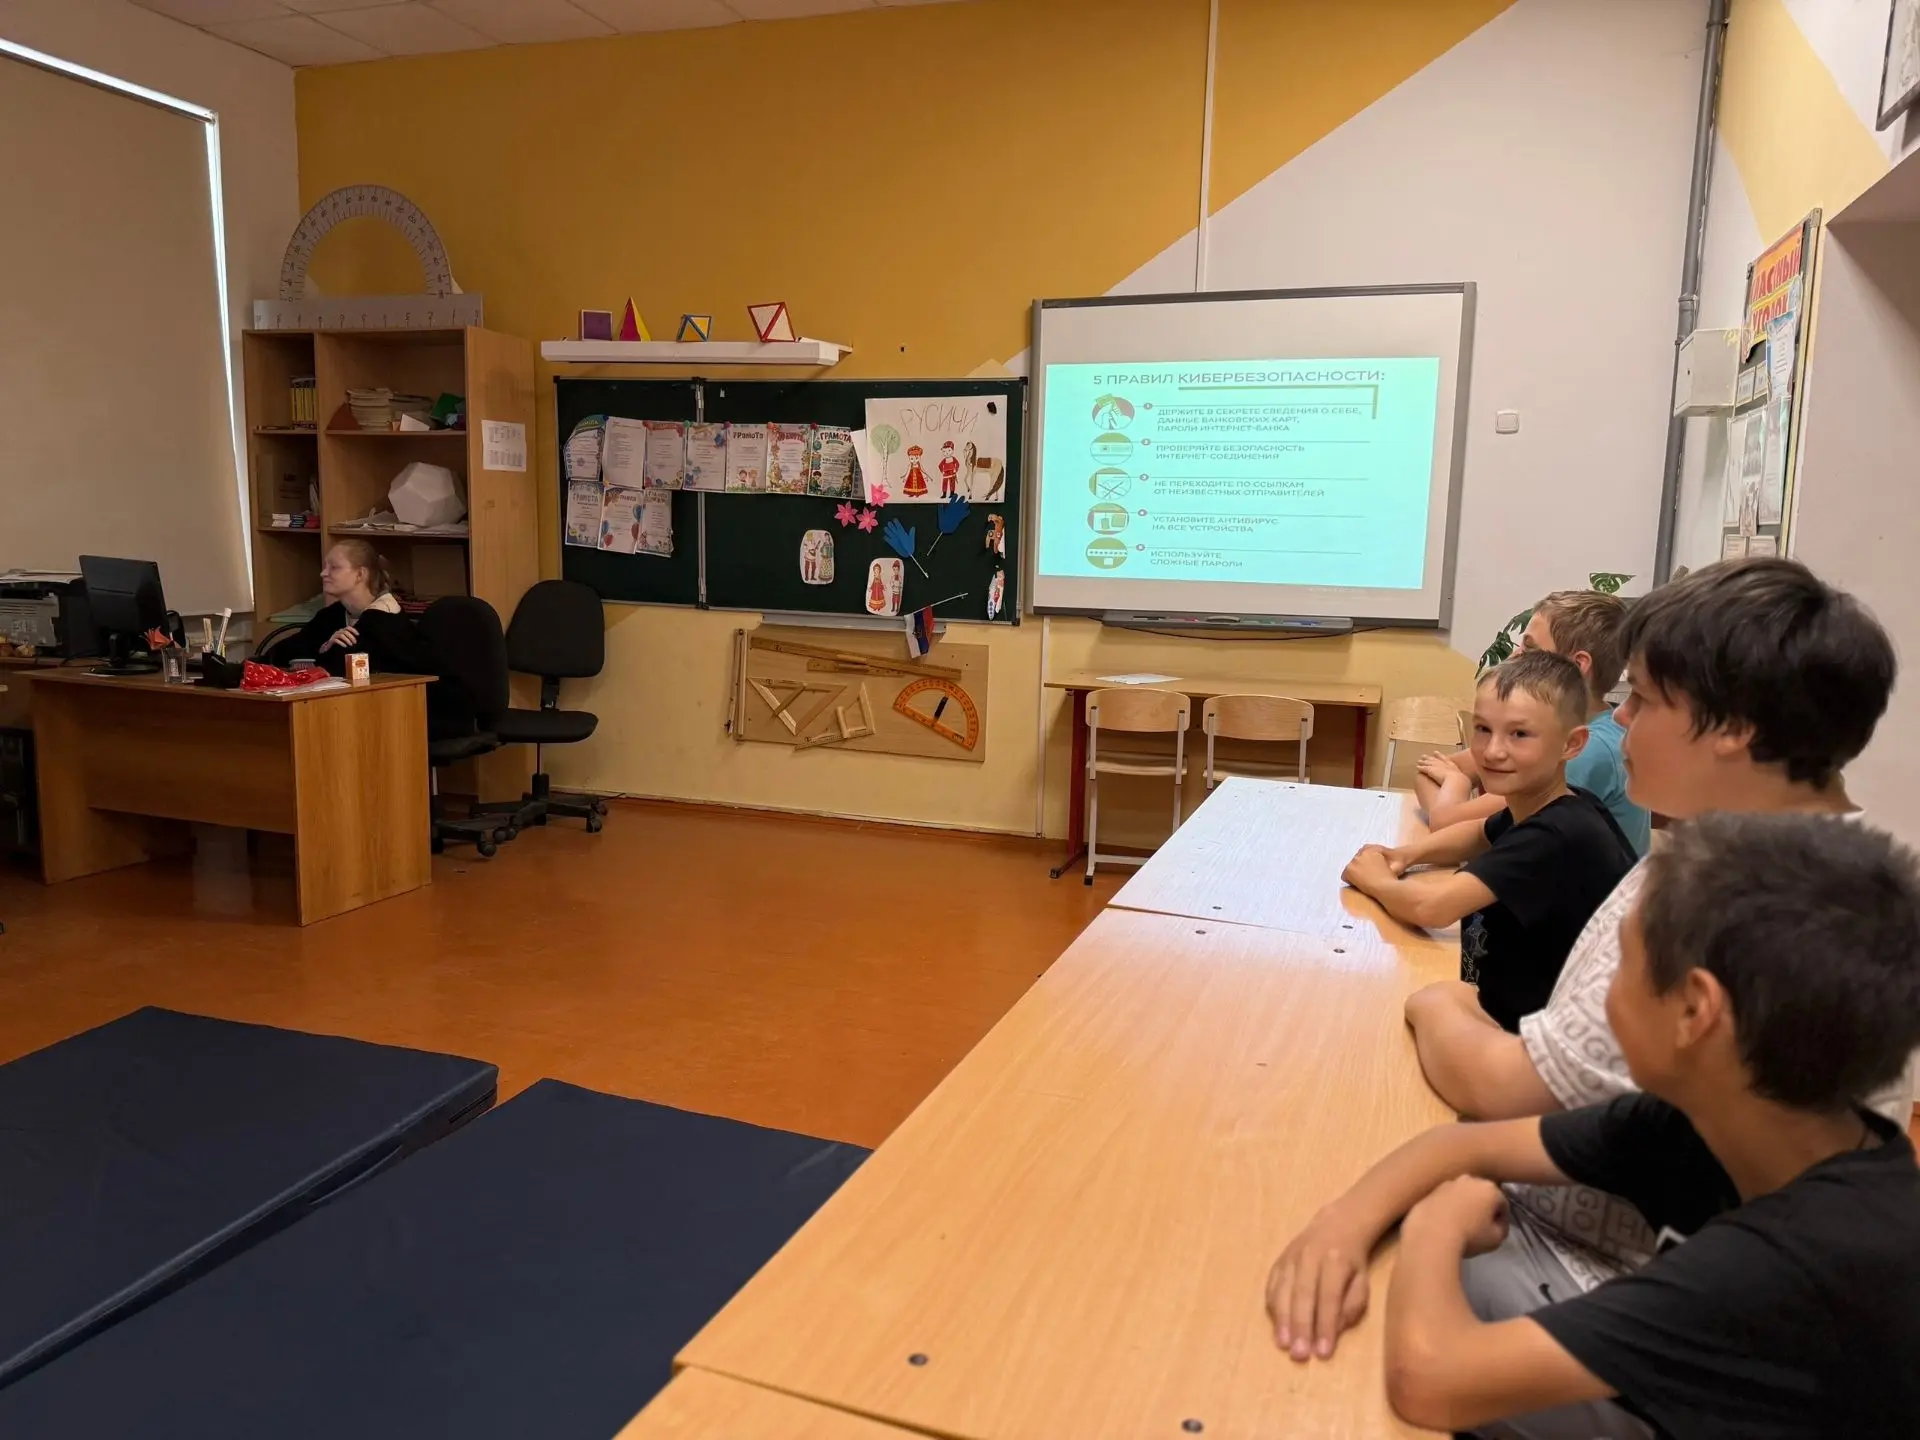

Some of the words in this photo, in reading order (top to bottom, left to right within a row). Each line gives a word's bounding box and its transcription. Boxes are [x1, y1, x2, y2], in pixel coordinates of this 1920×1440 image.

[1093, 375, 1102, 385] 5
[1106, 373, 1174, 385] ПРАВИЛ
[1177, 370, 1386, 384] КИБЕРБЕЗОПАСНОСТИ:
[1157, 408, 1205, 416] ДЕРЖИТЕ
[1215, 407, 1260, 415] СЕКРЕТЕ
[1262, 407, 1319, 415] СВЕДЕНИЯ
[1331, 407, 1362, 415] СЕБЕ,
[900, 403, 979, 436] РУСИЧИ
[1157, 416, 1200, 424] ДАННЫЕ
[1201, 416, 1271, 424] БАНКОВСКИХ
[820, 431, 852, 443] ГРАМОТА
[1156, 443, 1221, 452] ПРОВЕРЯЙТЕ
[1223, 444, 1305, 452] БЕЗОПАСНОСТЬ
[1155, 452, 1280, 460] ИНТЕРНЕТ-СОЕДИНЕНИЯ
[1169, 480, 1234, 488] ПЕРЕХОДИТЕ
[1243, 489, 1325, 497] ОТПРАВИТЕЛЕЙ
[1188, 524, 1254, 532] УСТРОЙСТВА
[1150, 550, 1222, 558] ИСПОЛЬЗУЙТЕ
[1149, 559, 1199, 567] СЛОЖНЫЕ
